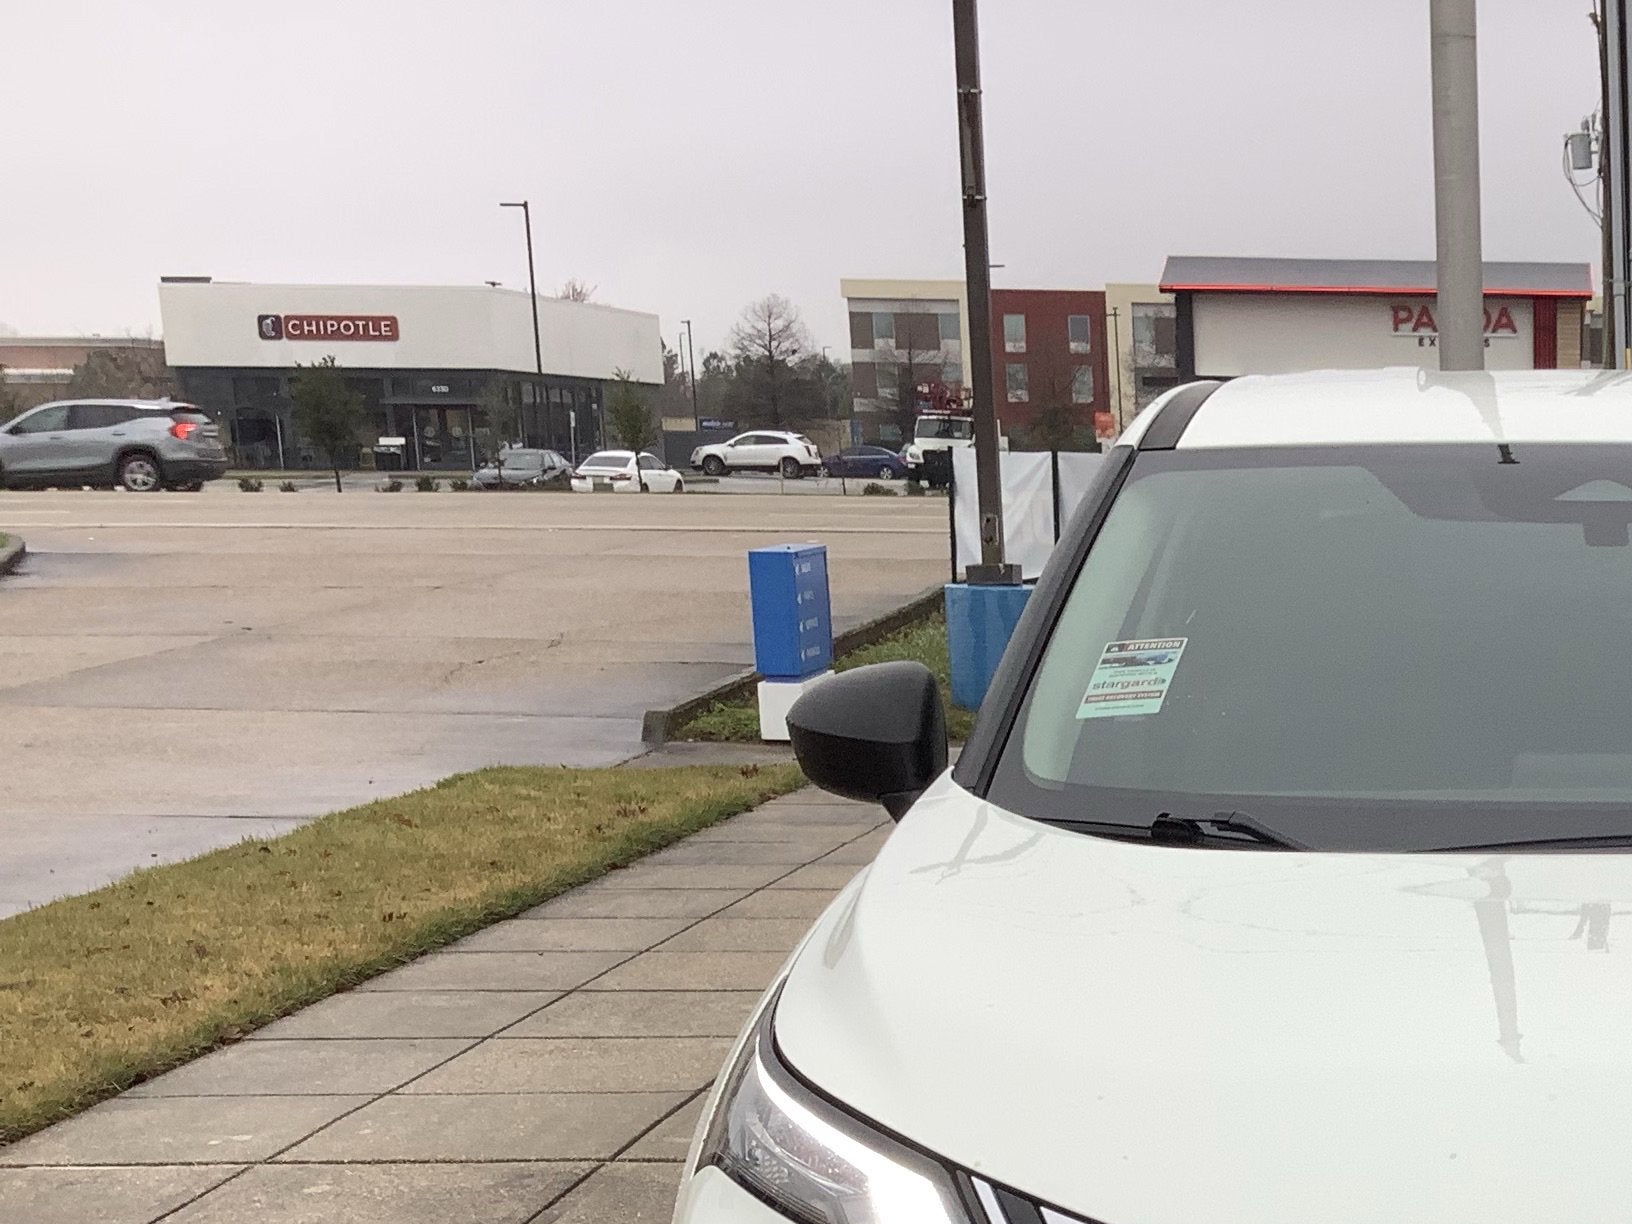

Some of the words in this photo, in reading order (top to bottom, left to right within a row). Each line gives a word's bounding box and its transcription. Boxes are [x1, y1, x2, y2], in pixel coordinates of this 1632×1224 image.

[1390, 304, 1518, 333] PAA
[288, 320, 392, 336] CHIPOTLE
[1127, 641, 1181, 651] ATTENTION
